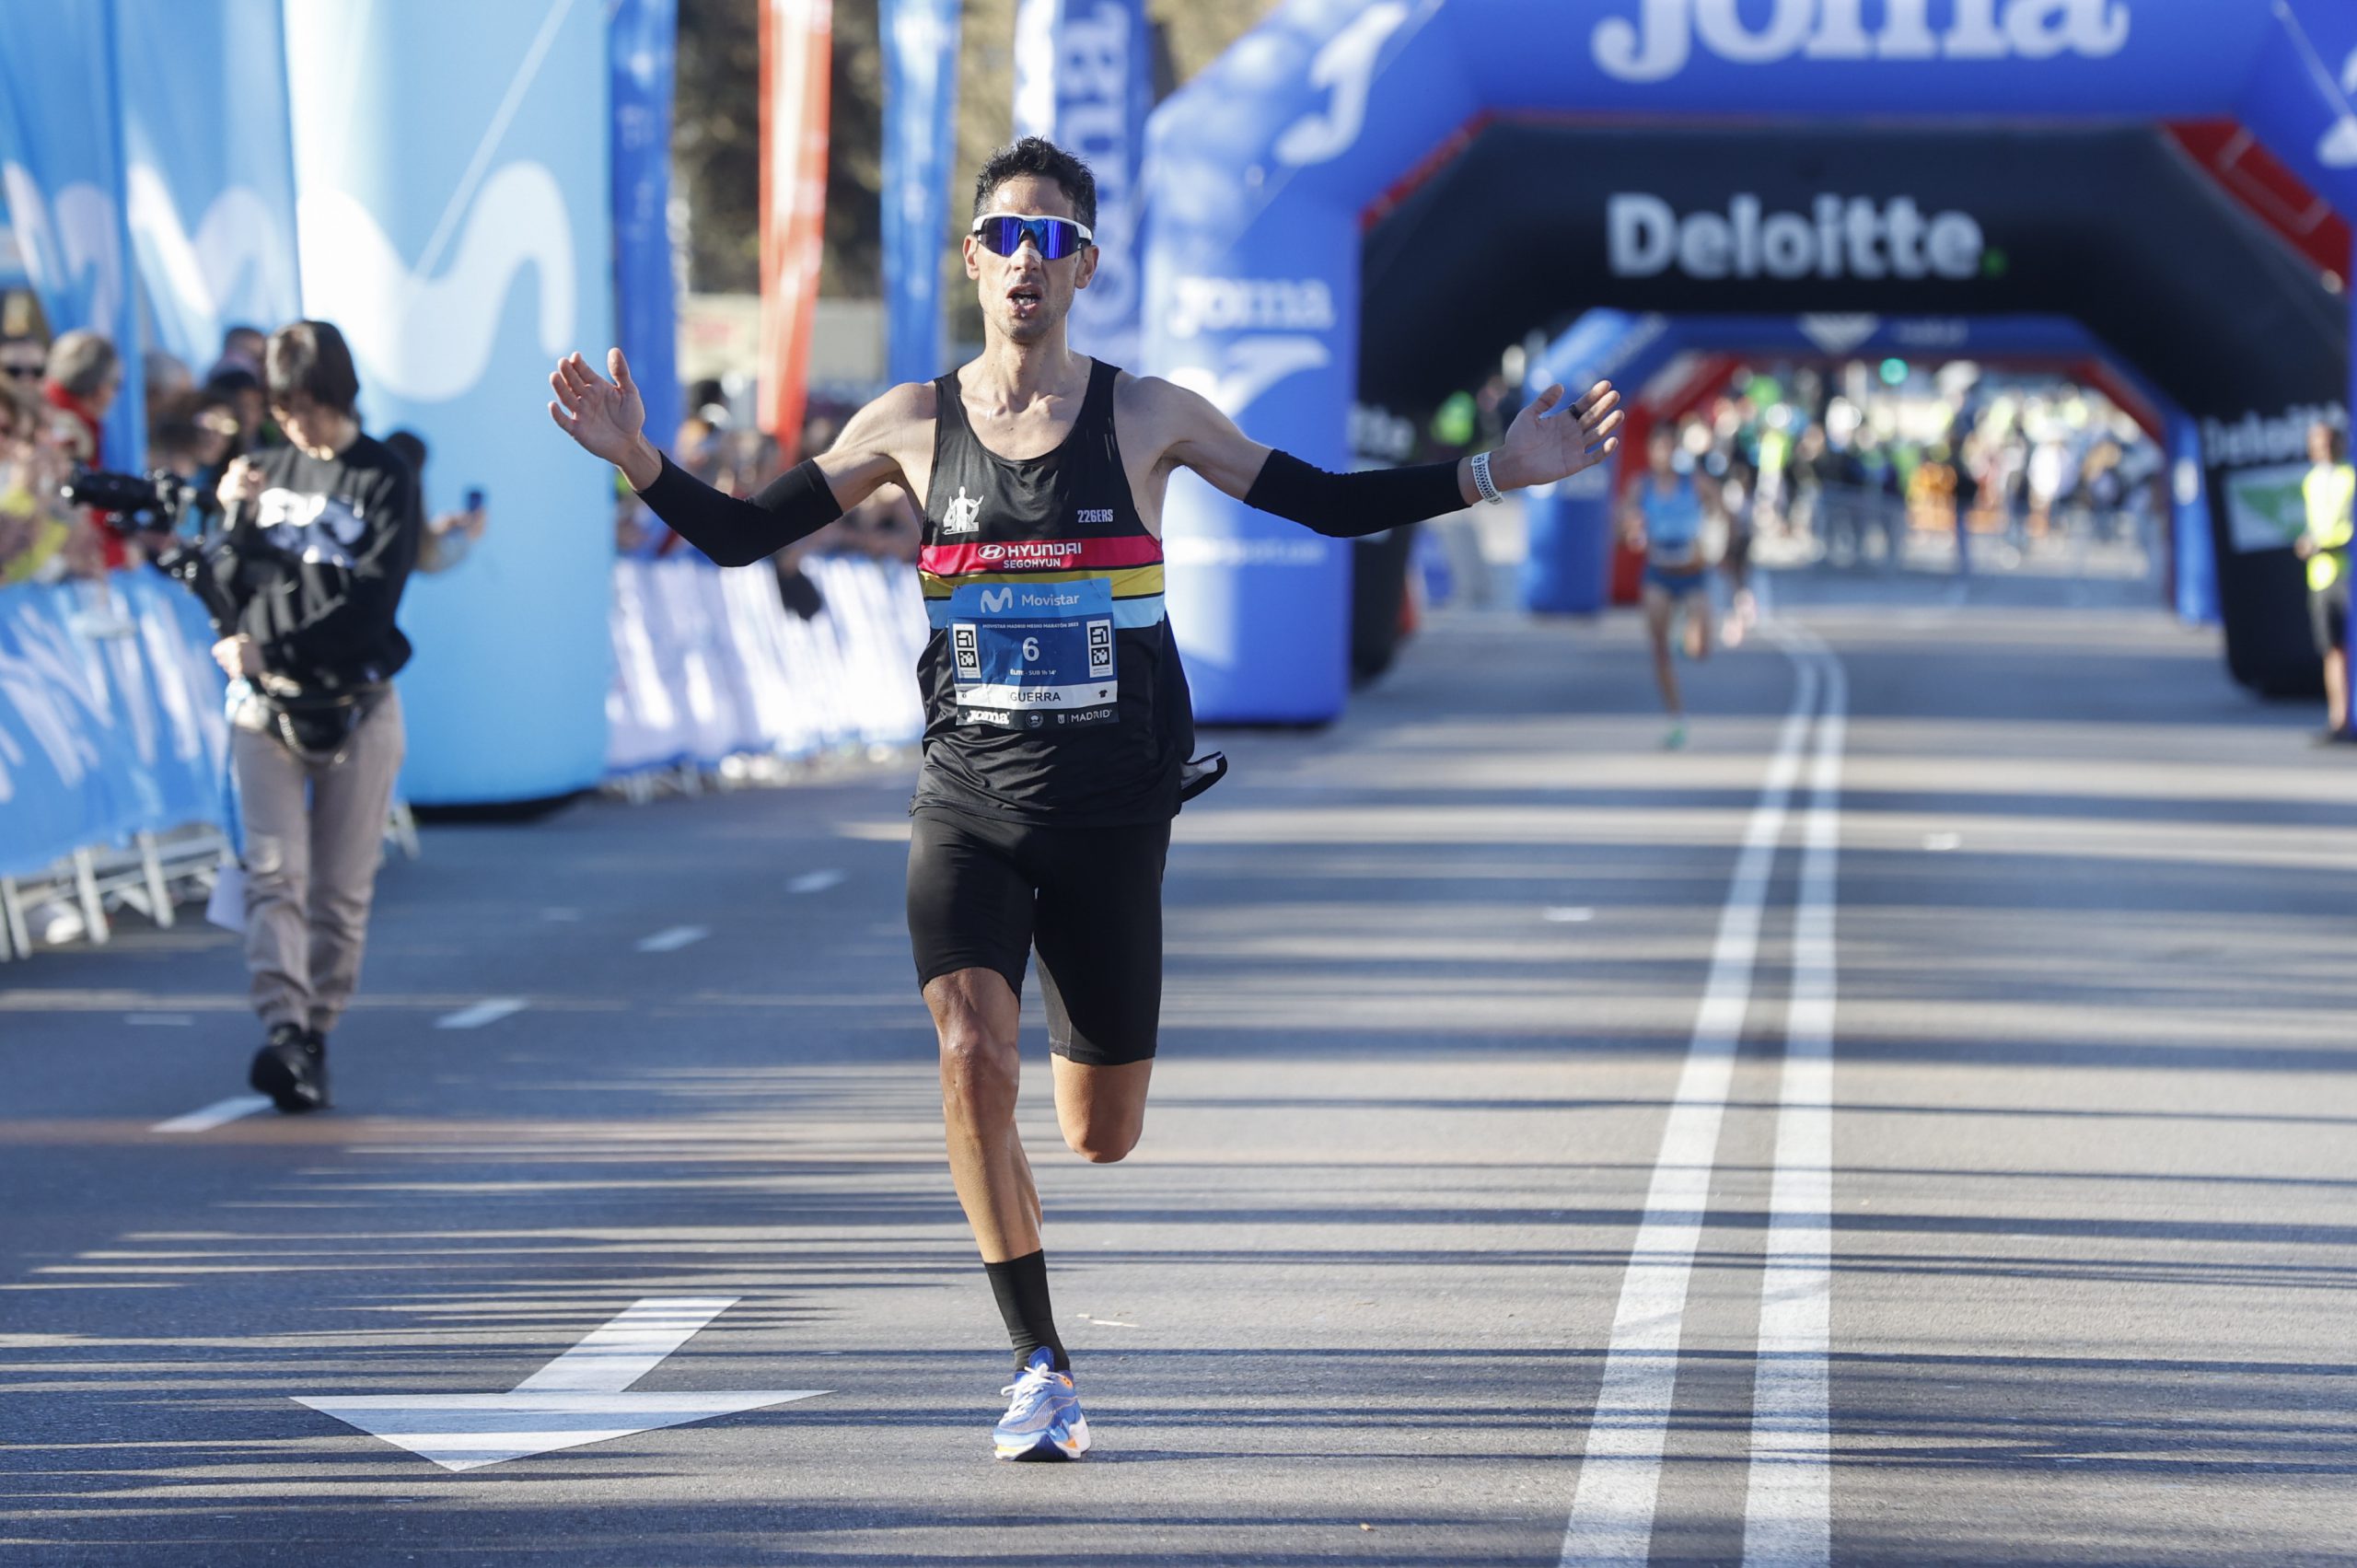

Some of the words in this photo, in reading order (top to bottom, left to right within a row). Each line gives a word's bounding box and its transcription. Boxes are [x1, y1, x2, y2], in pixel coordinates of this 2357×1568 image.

[1076, 508, 1114, 523] 226ERS
[1007, 542, 1082, 557] HYUNDAI
[1004, 558, 1061, 569] SEGOHYUN
[1021, 594, 1080, 607] Movistar
[1022, 636, 1039, 661] 6
[1010, 692, 1062, 703] GUERRA
[1071, 711, 1110, 723] MADRID
